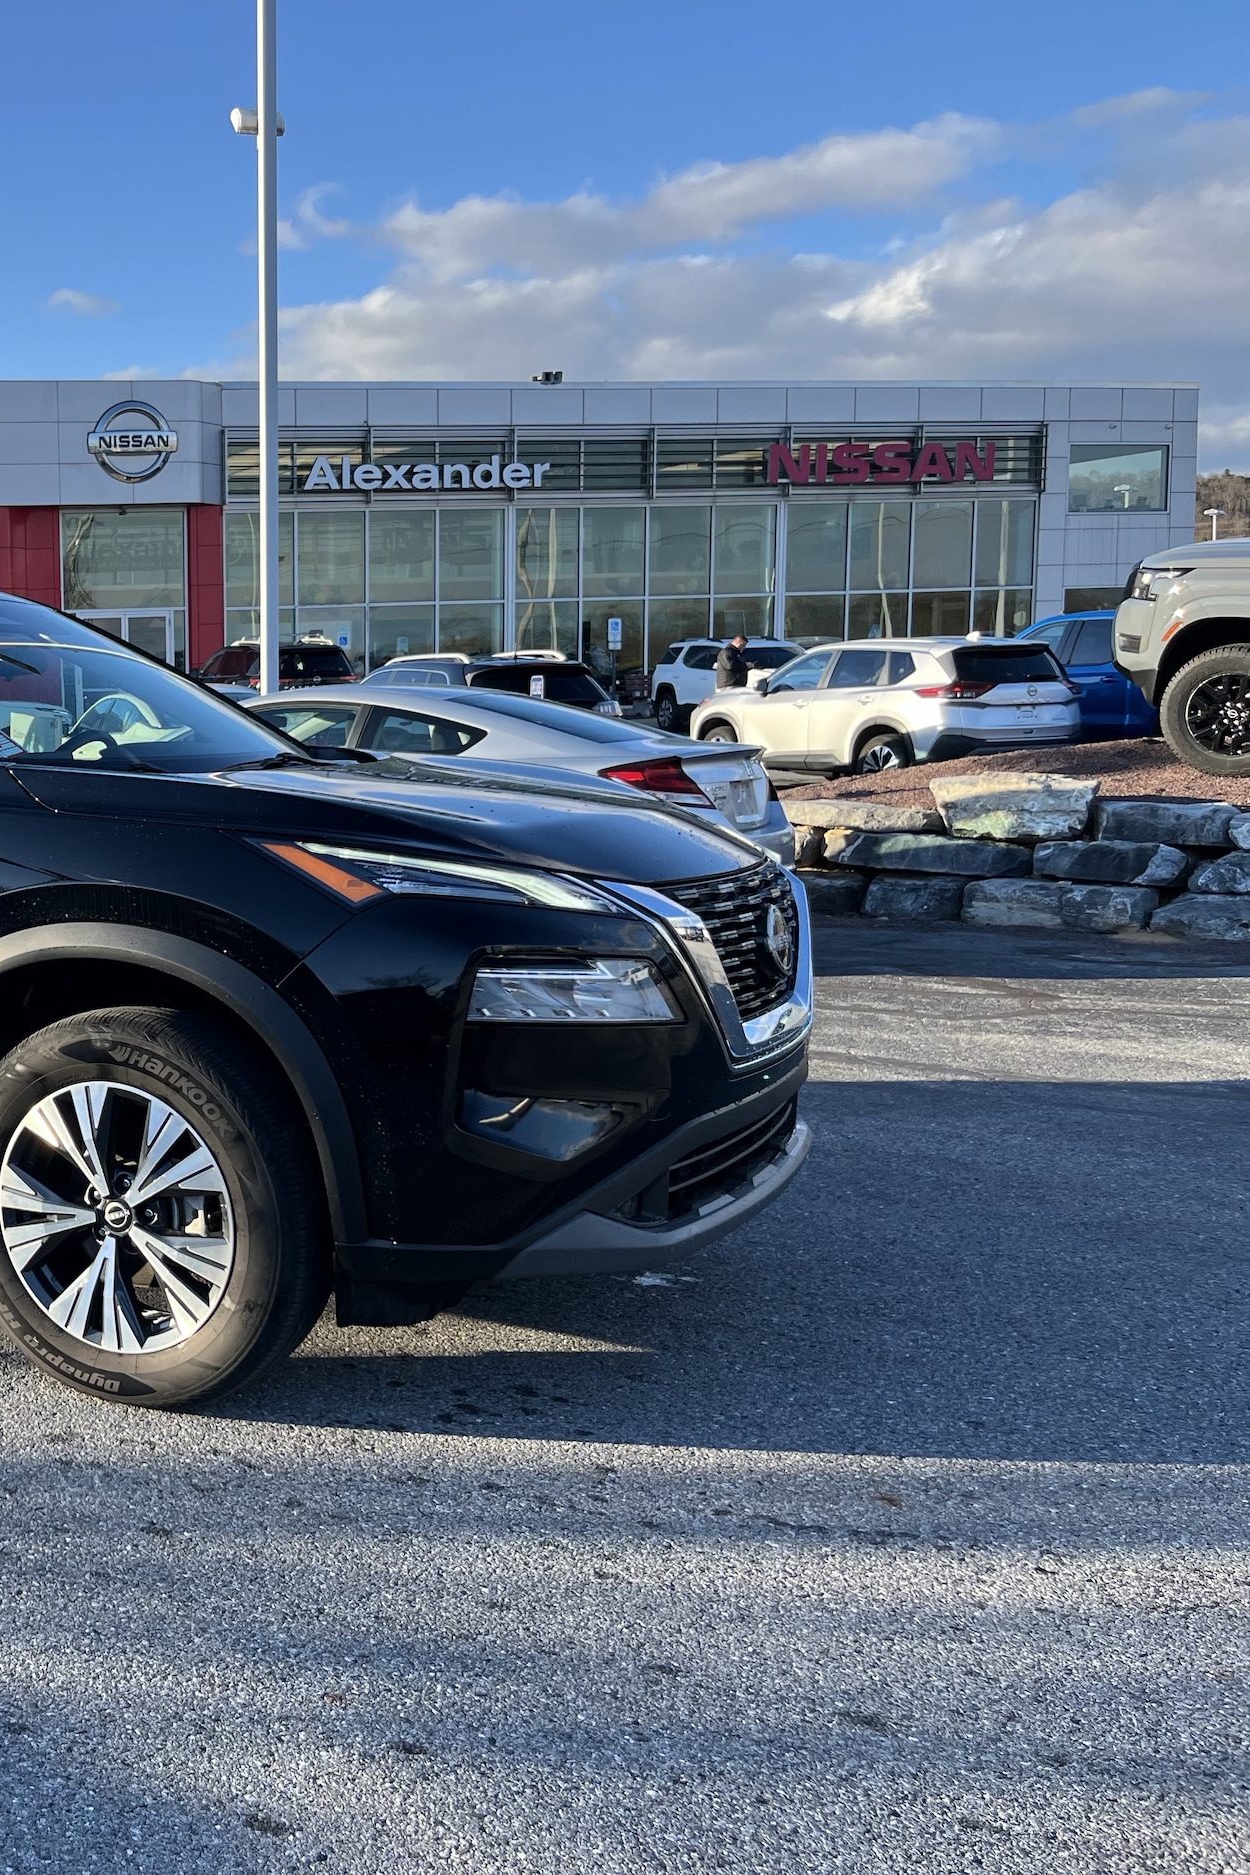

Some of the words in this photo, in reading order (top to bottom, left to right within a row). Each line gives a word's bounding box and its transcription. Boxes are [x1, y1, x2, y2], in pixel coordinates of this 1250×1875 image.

[98, 434, 169, 449] NISSAN
[303, 454, 550, 490] Alexander
[766, 441, 996, 484] NISSAN
[22, 1333, 121, 1393] Dynapro
